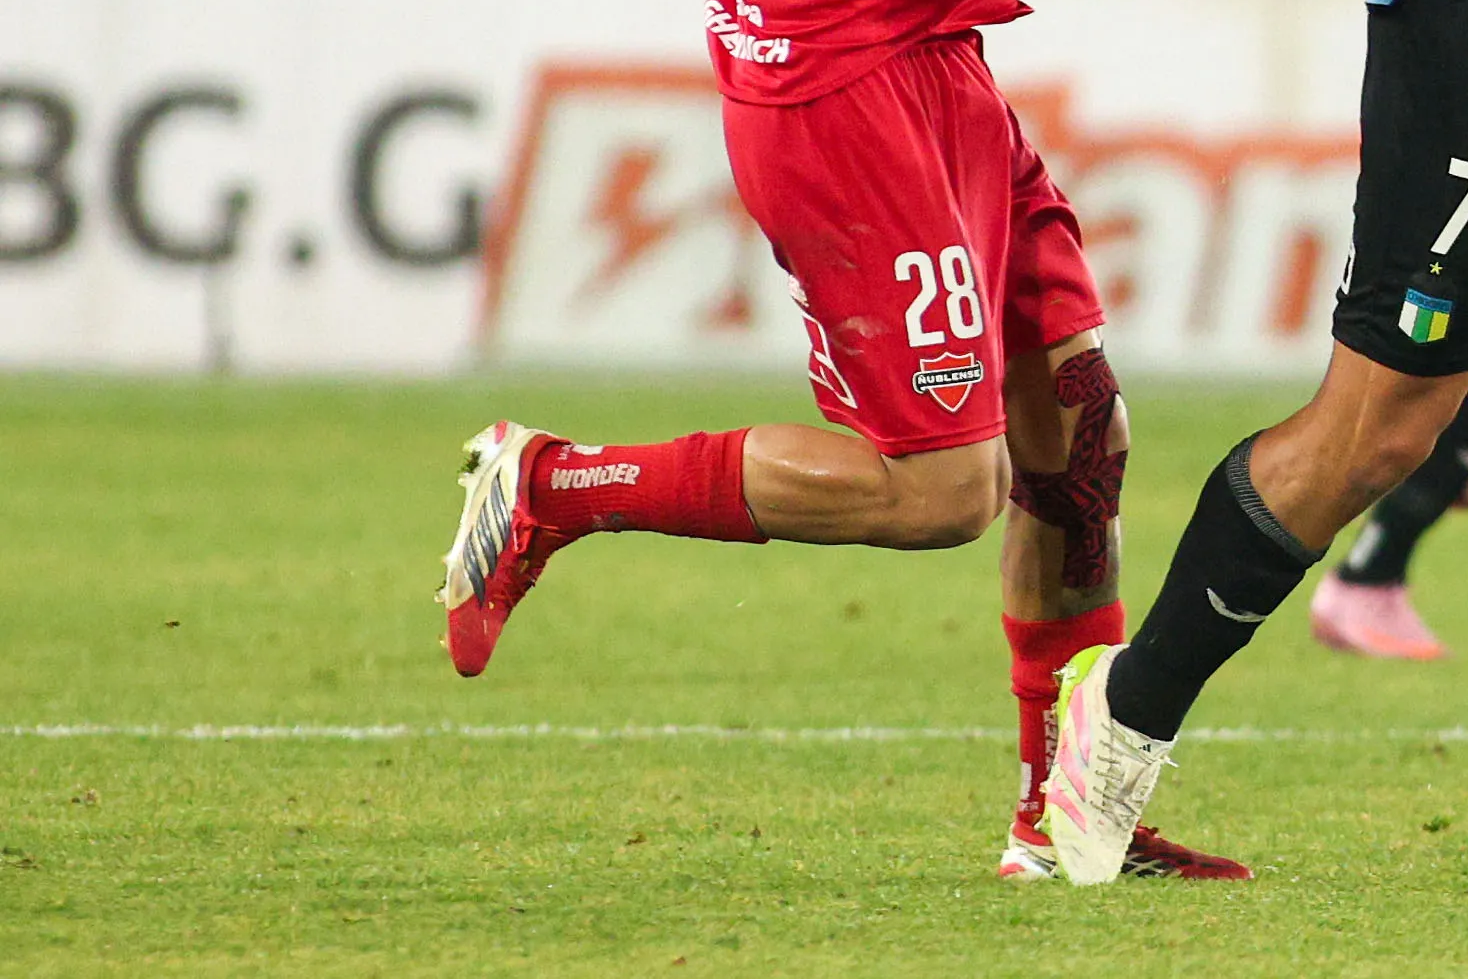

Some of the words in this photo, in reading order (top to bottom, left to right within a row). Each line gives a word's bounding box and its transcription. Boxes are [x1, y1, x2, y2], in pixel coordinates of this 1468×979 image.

[894, 245, 983, 347] 28
[917, 369, 981, 385] ÑUBLENSE
[550, 462, 641, 491] WONDER
